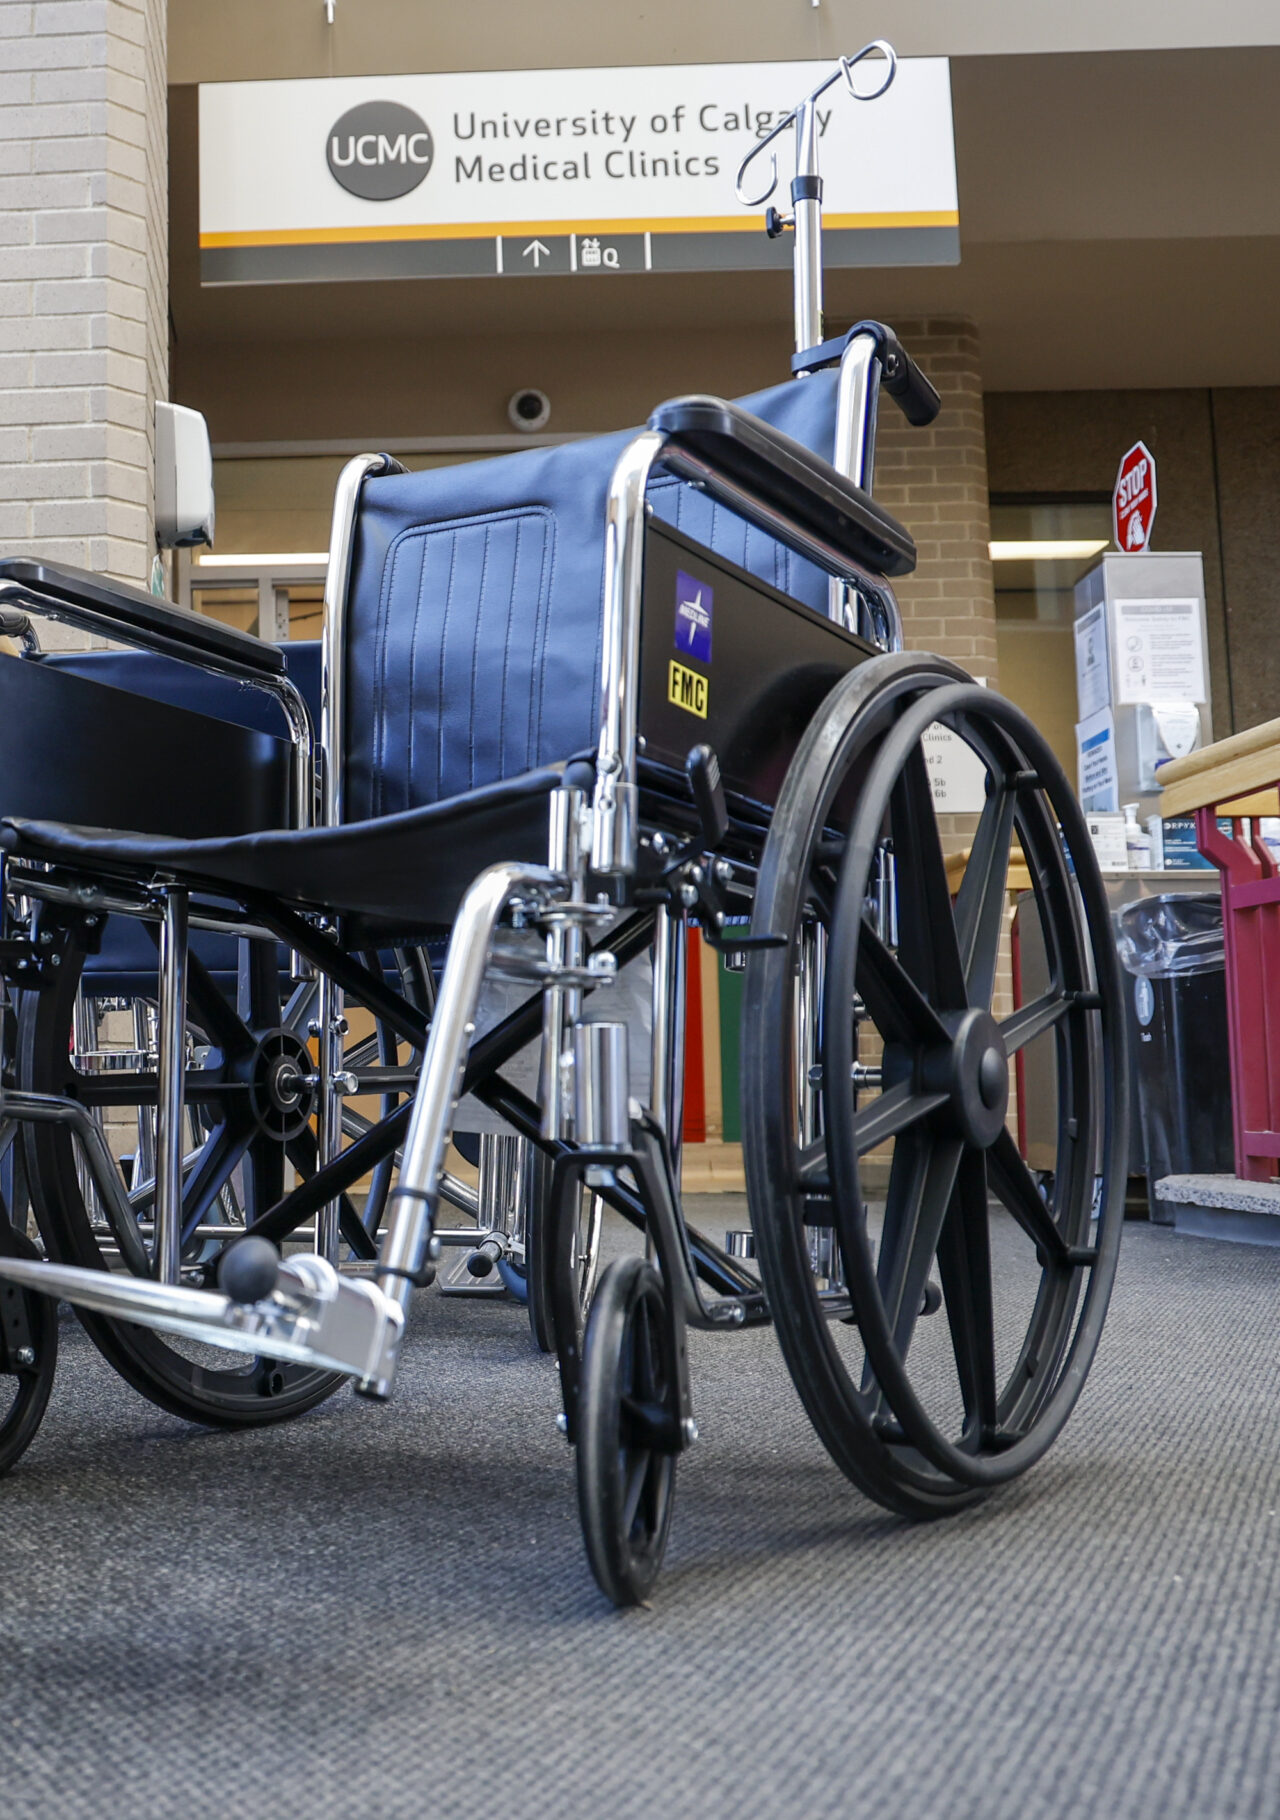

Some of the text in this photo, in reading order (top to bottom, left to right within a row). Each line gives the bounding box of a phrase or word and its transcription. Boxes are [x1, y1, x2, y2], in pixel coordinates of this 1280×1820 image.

[453, 103, 832, 142] University of Calgay
[331, 133, 429, 166] UCMC
[455, 150, 720, 183] Medical Clinics
[1119, 458, 1148, 508] STOP
[672, 665, 704, 712] FMC
